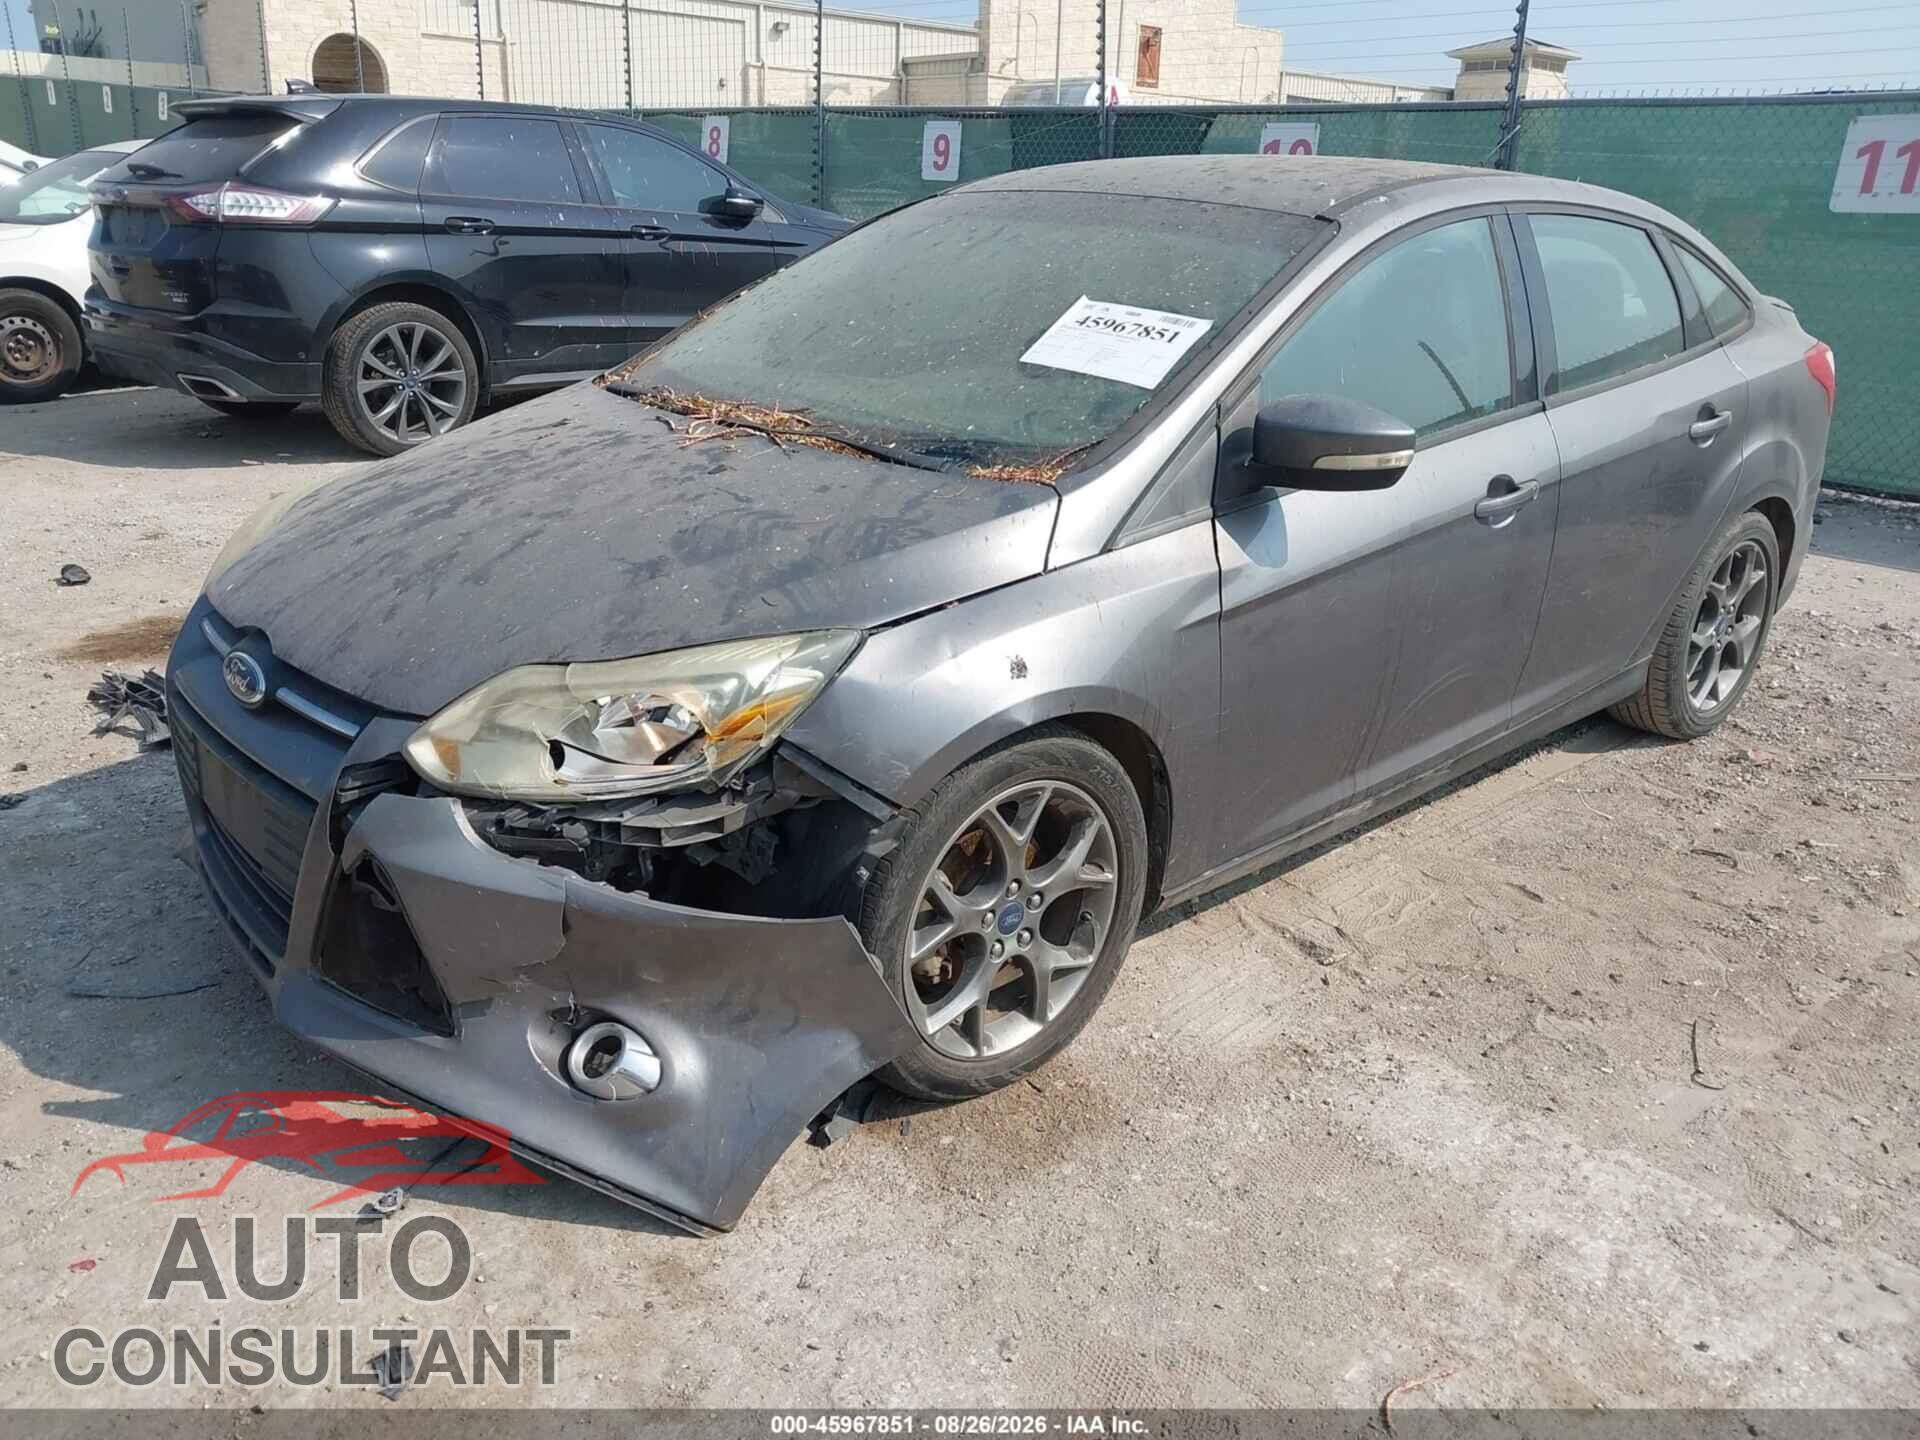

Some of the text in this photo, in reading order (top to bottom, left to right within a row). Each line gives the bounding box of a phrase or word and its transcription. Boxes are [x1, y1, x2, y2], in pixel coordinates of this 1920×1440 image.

[708, 126, 721, 158] 8
[932, 133, 951, 172] 9
[1856, 139, 1920, 195] 11
[1075, 316, 1180, 343] 45967851
[226, 658, 251, 692] Ford
